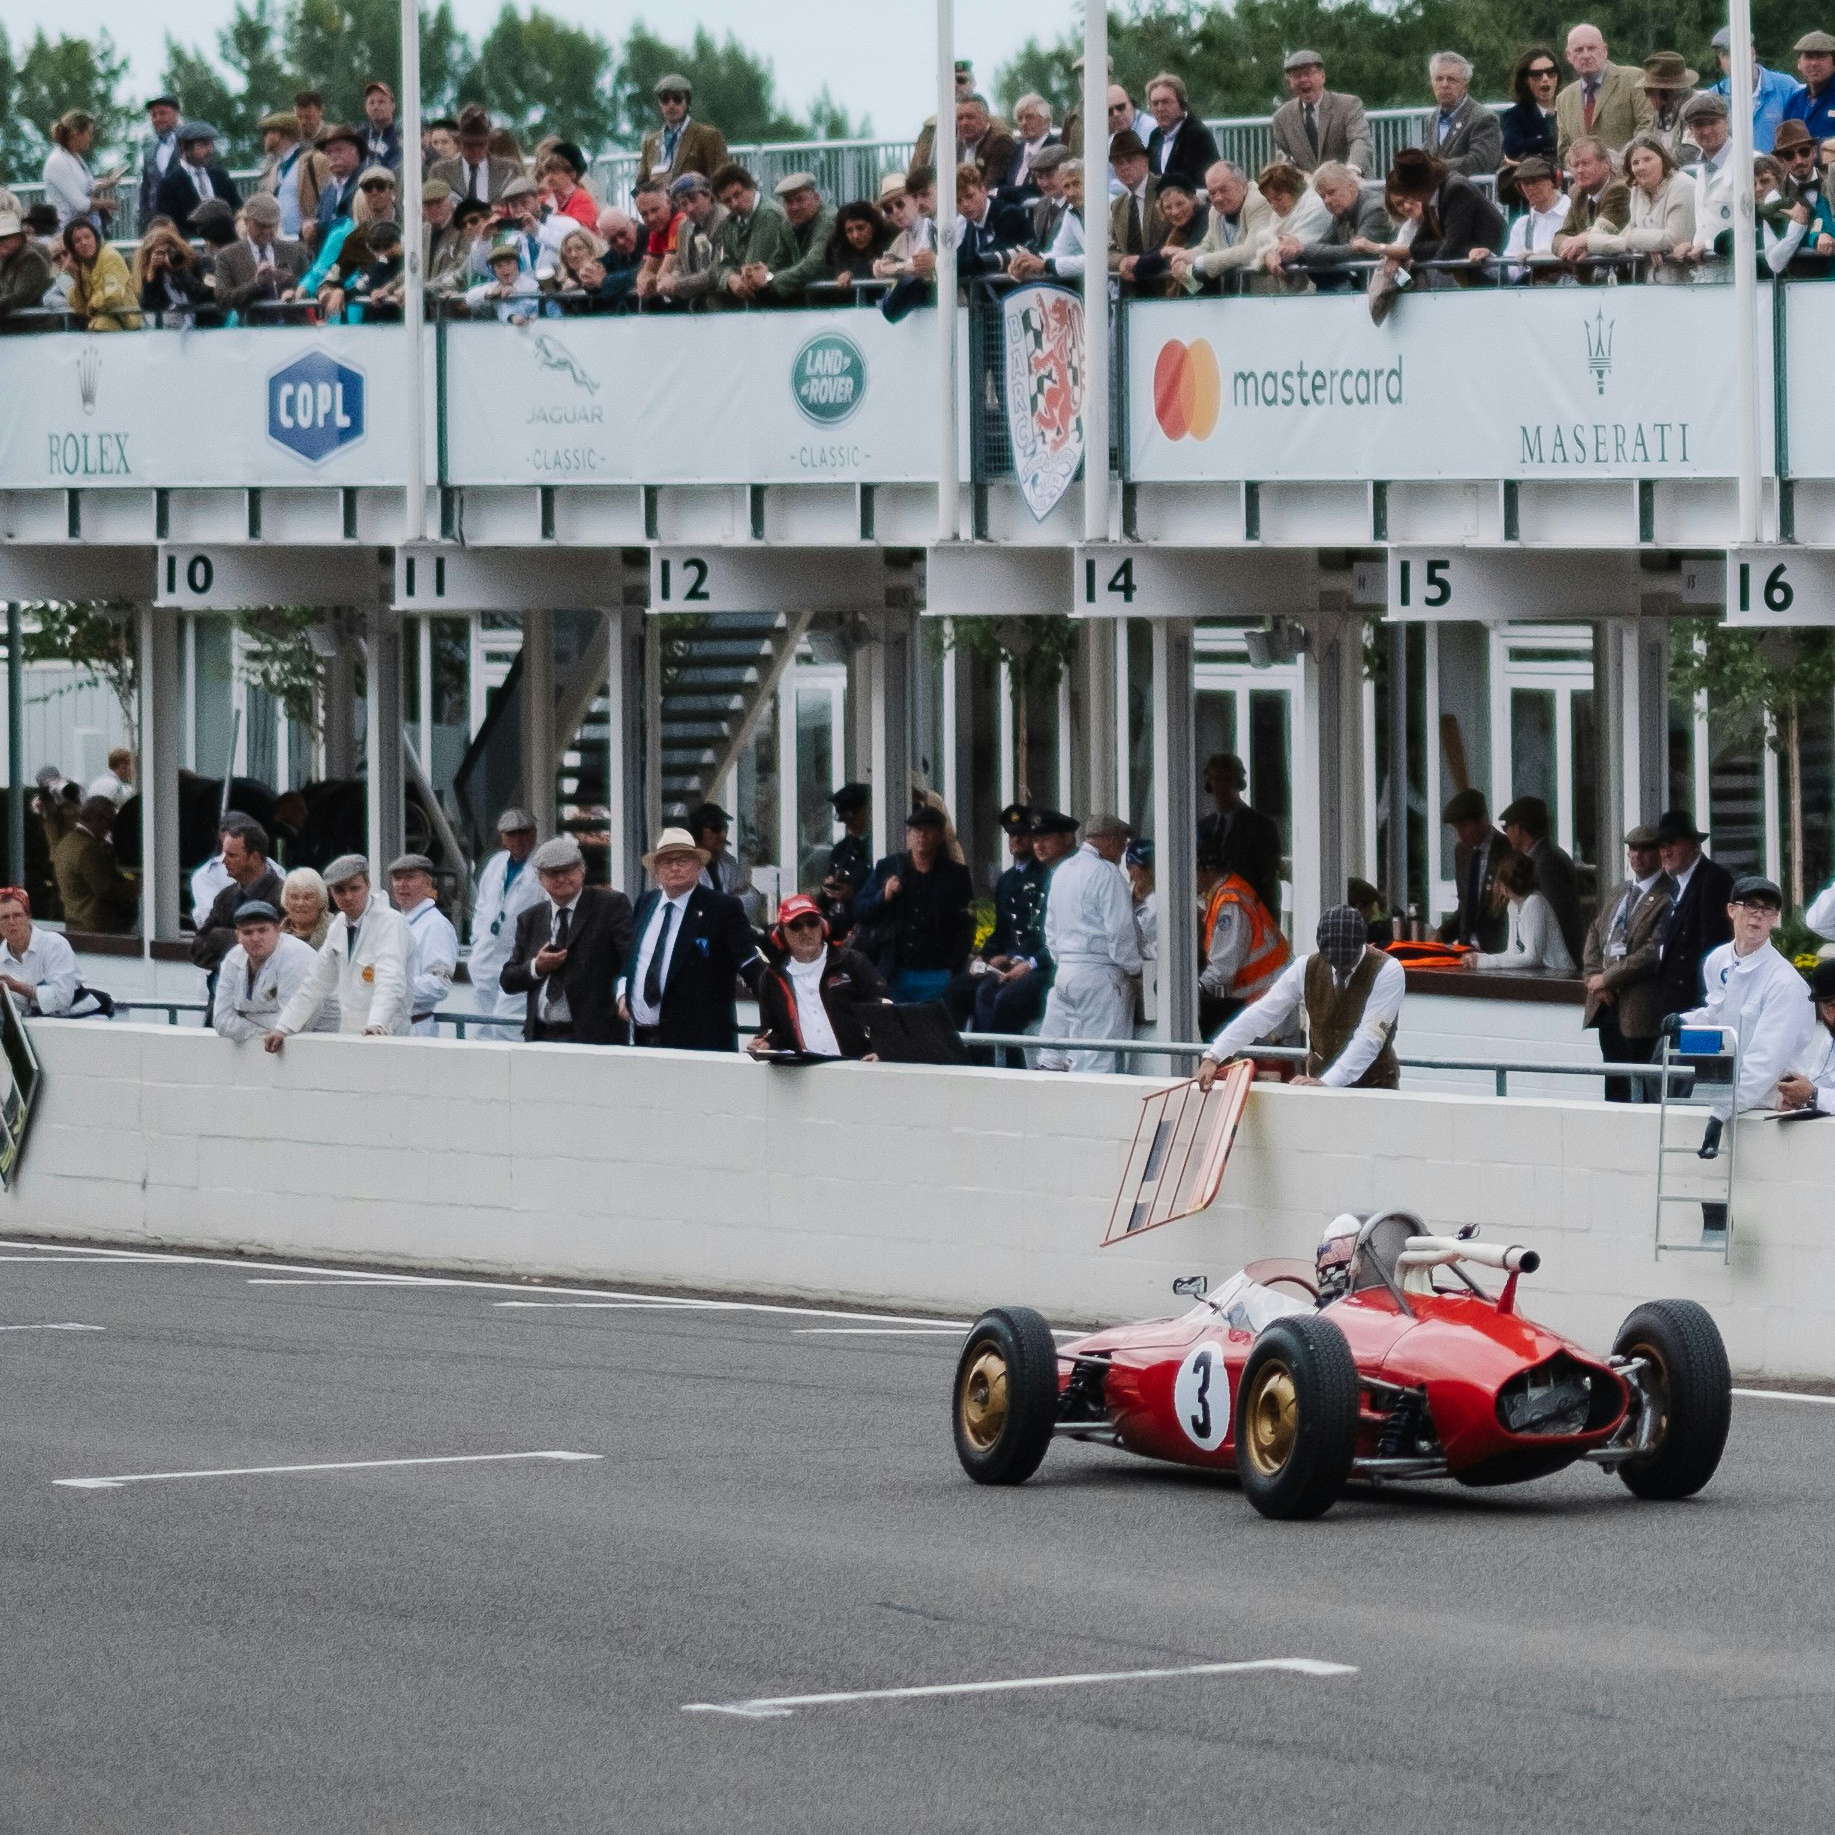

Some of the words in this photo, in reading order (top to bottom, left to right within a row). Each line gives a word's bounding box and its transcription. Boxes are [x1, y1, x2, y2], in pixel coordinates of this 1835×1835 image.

[806, 348, 843, 376] LAND
[1233, 354, 1403, 408] mastercard
[278, 379, 352, 432] COPL
[808, 376, 855, 404] ROVER
[526, 406, 604, 425] JAGUAR
[48, 432, 132, 476] ROLEX
[1519, 422, 1691, 465] MASERATI
[168, 555, 213, 593] 10
[407, 557, 445, 596] 11
[661, 558, 709, 600] 12
[1085, 558, 1137, 602] 14
[1400, 560, 1451, 606] 15
[1740, 564, 1794, 611] 16
[1191, 1349, 1214, 1440] 3
